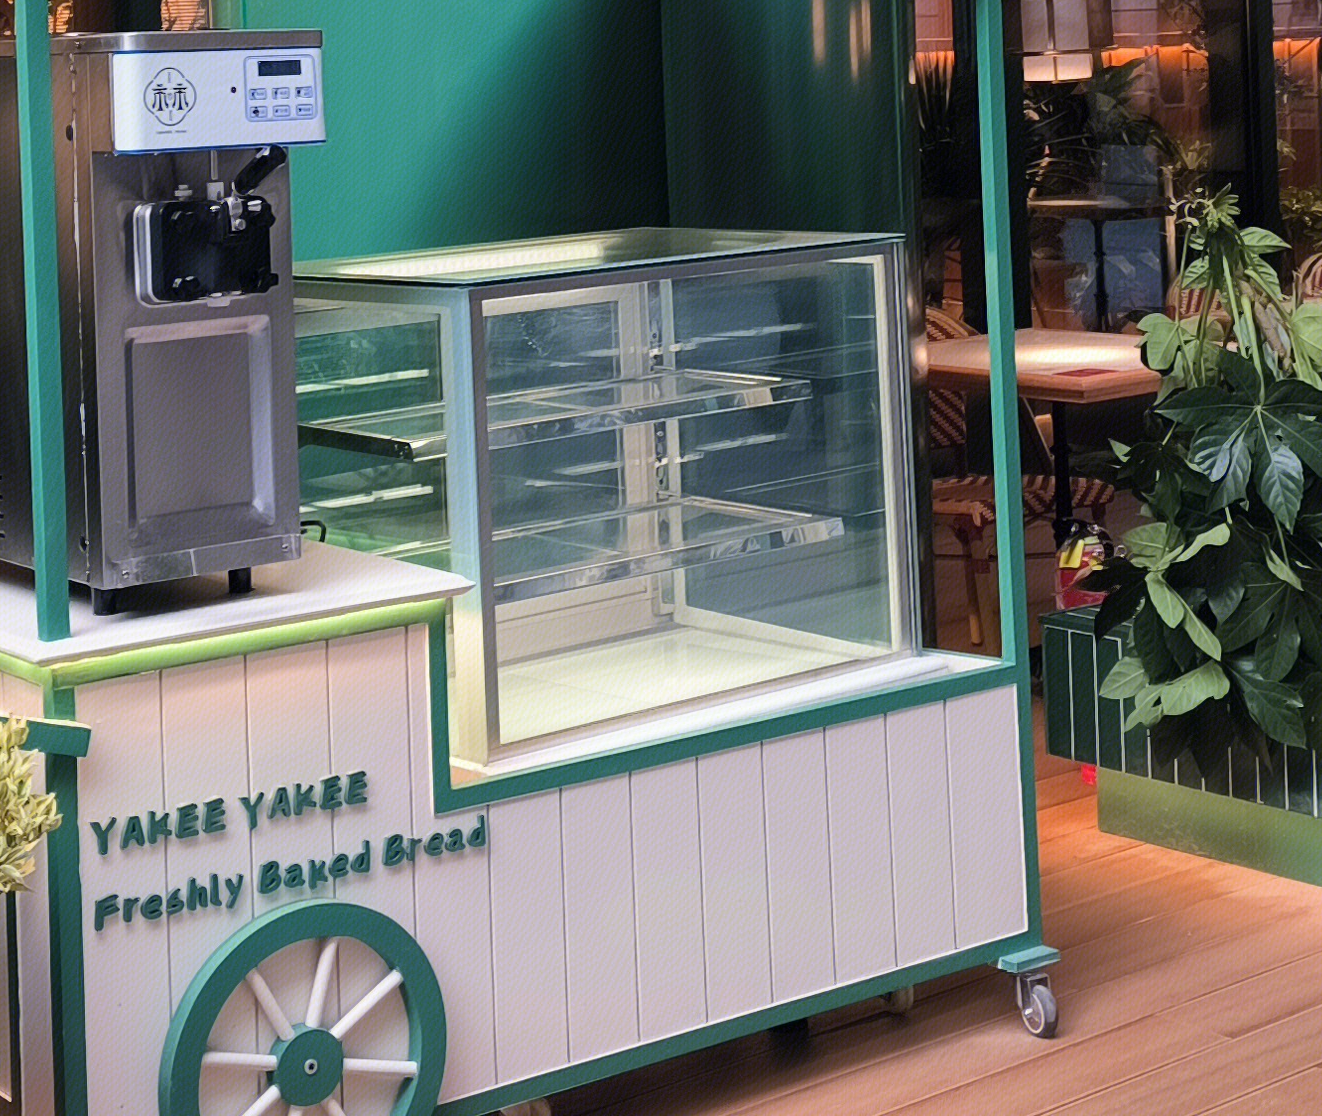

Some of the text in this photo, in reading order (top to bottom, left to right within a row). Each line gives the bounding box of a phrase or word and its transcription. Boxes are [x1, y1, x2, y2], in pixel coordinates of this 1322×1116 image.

[89, 769, 369, 856] YAKEE YAKEE
[93, 813, 488, 932] Freshly Baked Bread
